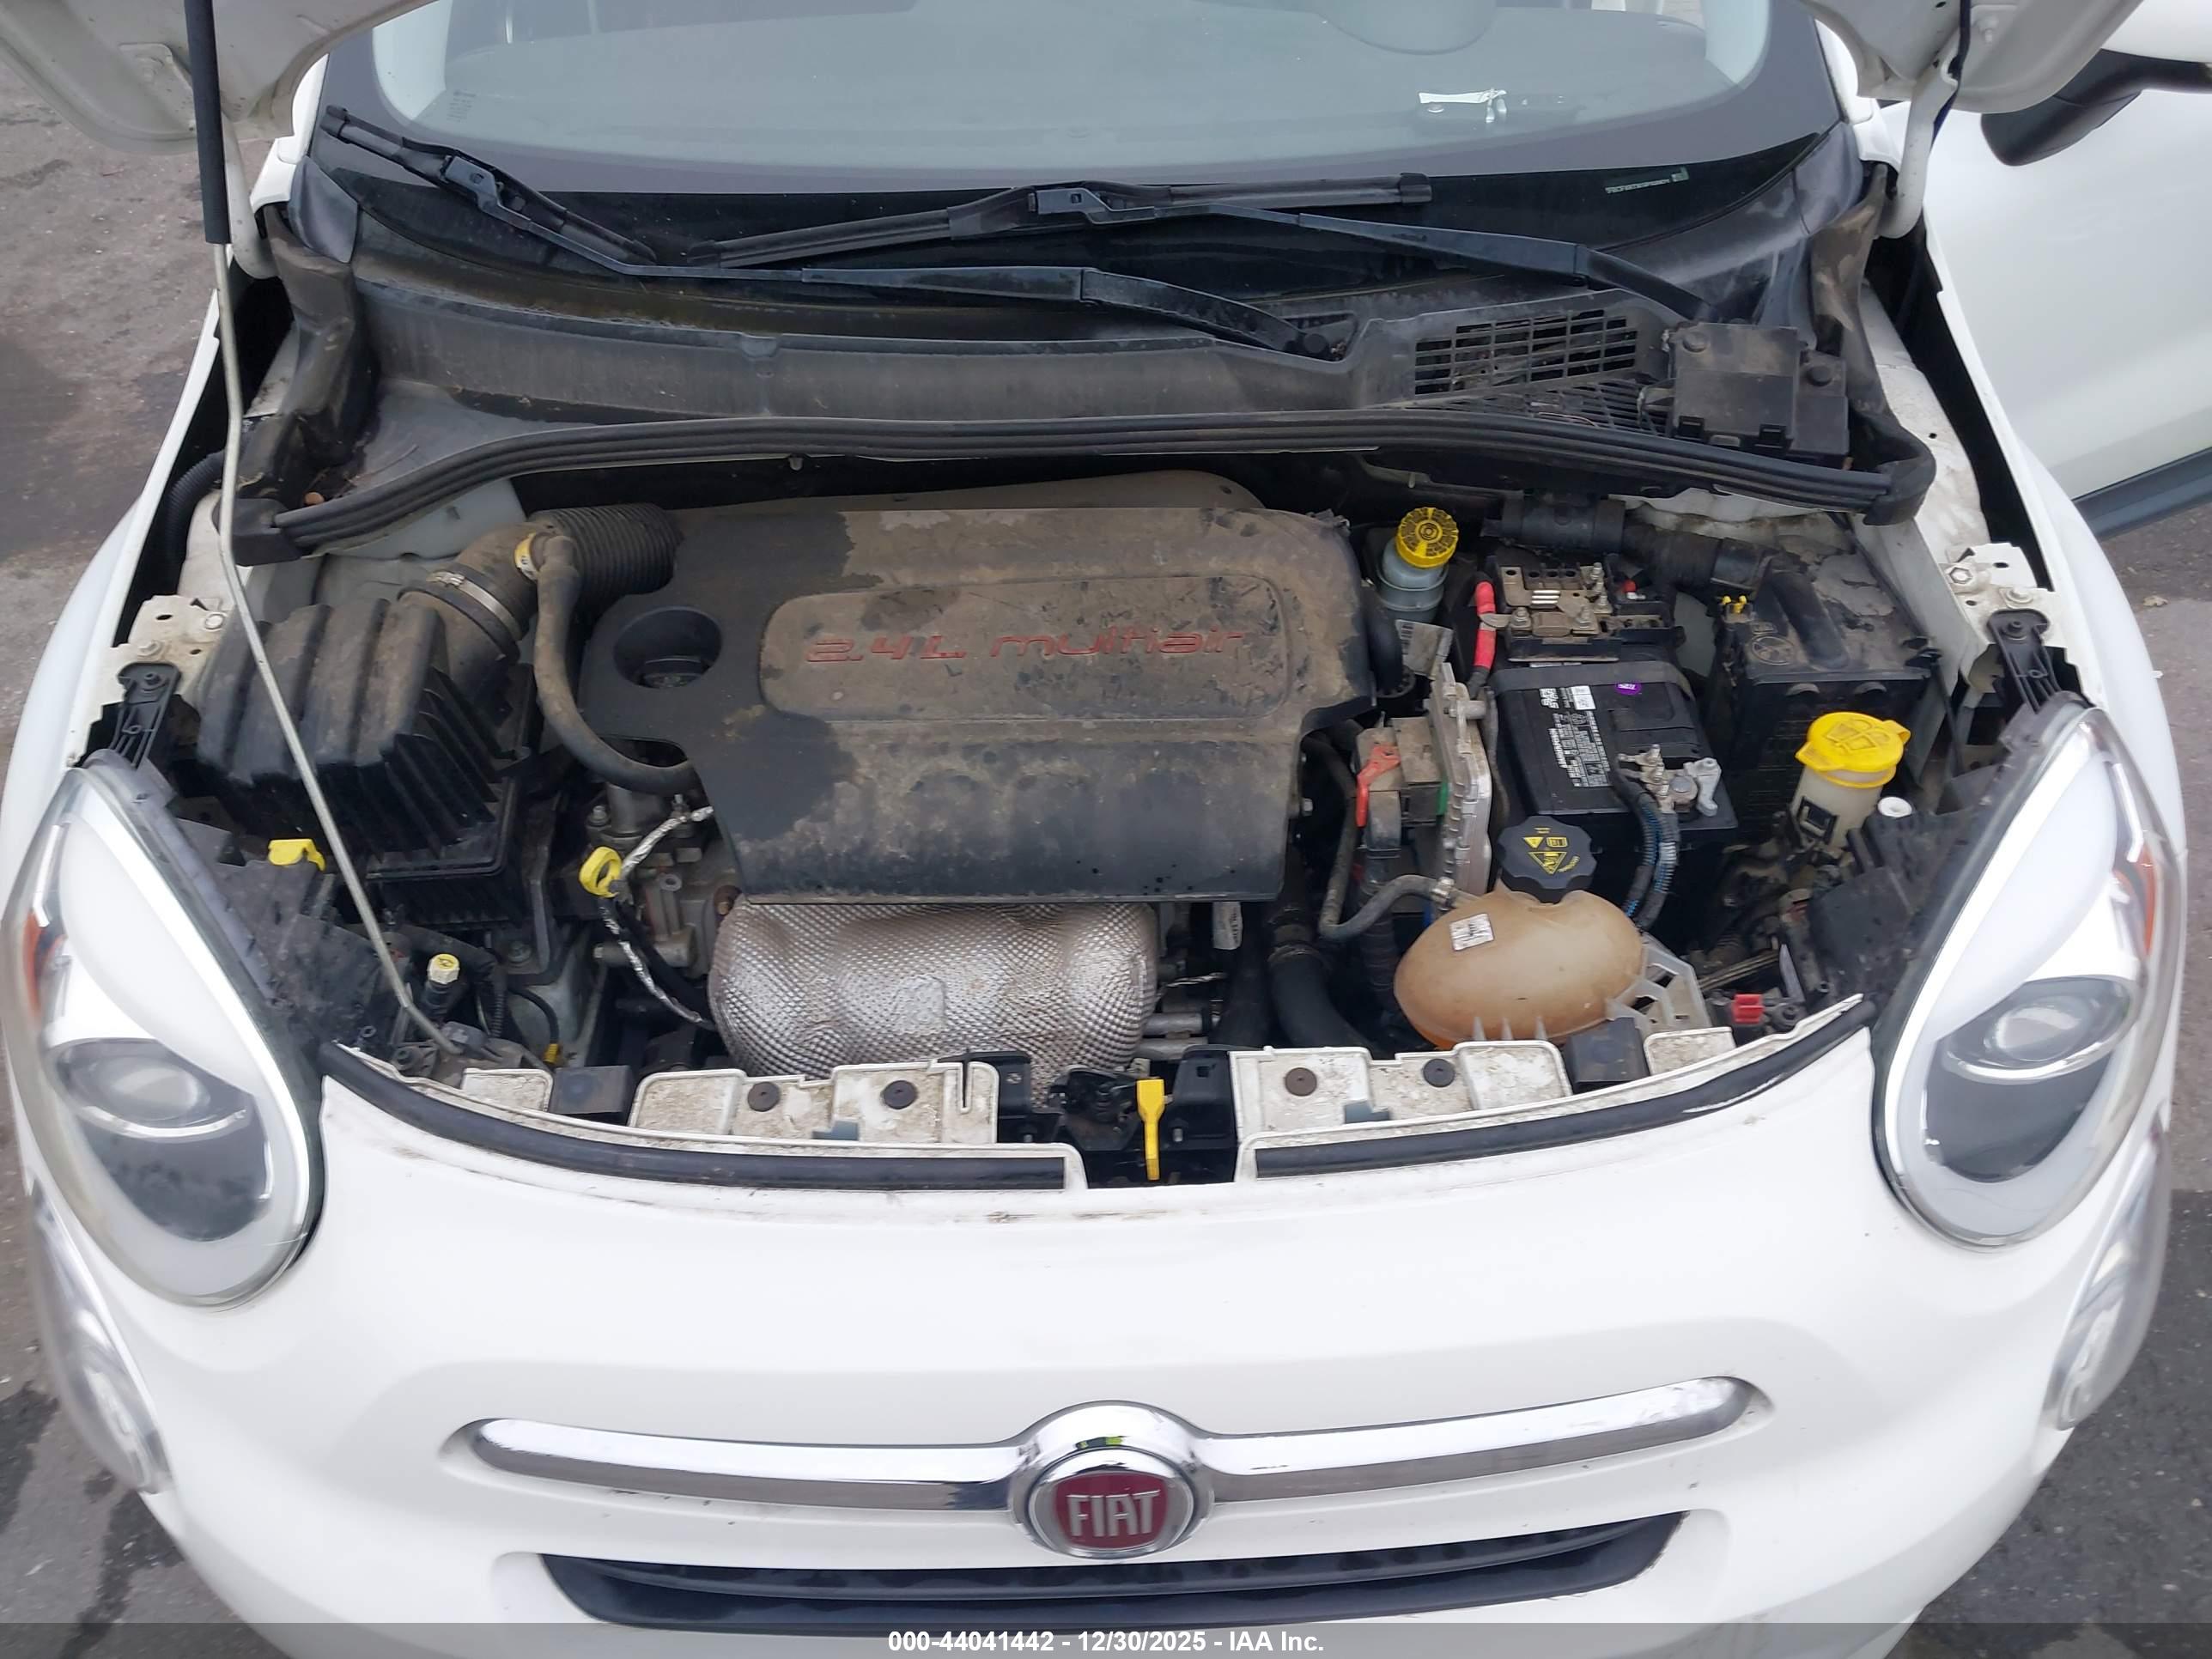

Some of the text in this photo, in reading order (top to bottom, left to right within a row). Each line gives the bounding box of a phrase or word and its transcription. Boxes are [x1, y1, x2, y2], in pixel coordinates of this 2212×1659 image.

[806, 626, 1245, 662] 2.4L multiair
[1066, 1490, 1160, 1536] FIAT
